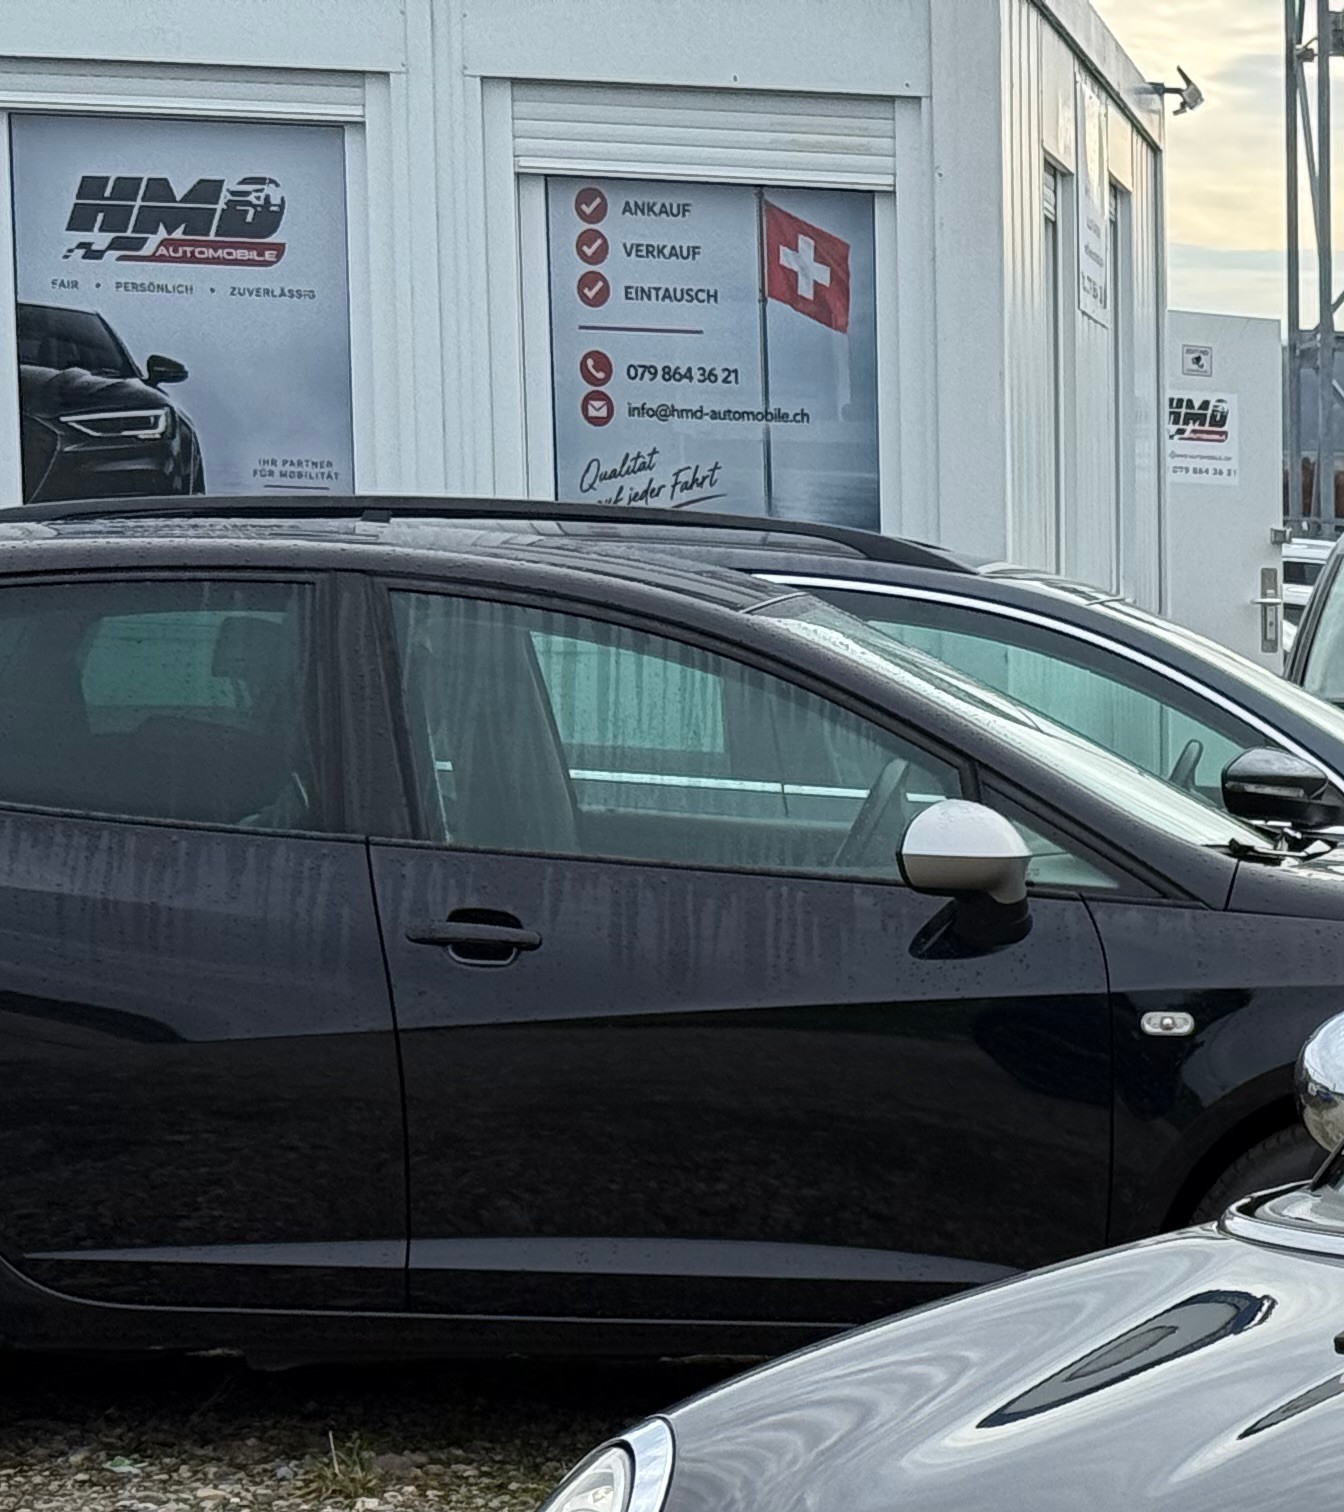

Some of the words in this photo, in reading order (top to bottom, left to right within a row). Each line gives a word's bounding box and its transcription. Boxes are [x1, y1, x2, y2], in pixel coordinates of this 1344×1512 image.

[65, 175, 286, 239] HMD
[622, 201, 692, 218] ANKAUF
[155, 245, 278, 262] AUTOMOBILE
[622, 243, 701, 261] VERKAUF
[51, 278, 79, 290] FAIR
[115, 281, 194, 295] PERSÖNLICH
[229, 286, 317, 300] ZUVERLÄSSIG
[624, 285, 719, 304] EINTAUSCH
[626, 364, 658, 382] 079
[661, 366, 693, 383] 864
[696, 367, 717, 384] 36
[721, 368, 739, 385] 21
[627, 402, 810, 425] info@hmd-automobile.ch
[258, 458, 280, 468] IHR
[579, 447, 660, 493] Qualität
[627, 477, 666, 505] jeder
[670, 461, 722, 500] Fahrt
